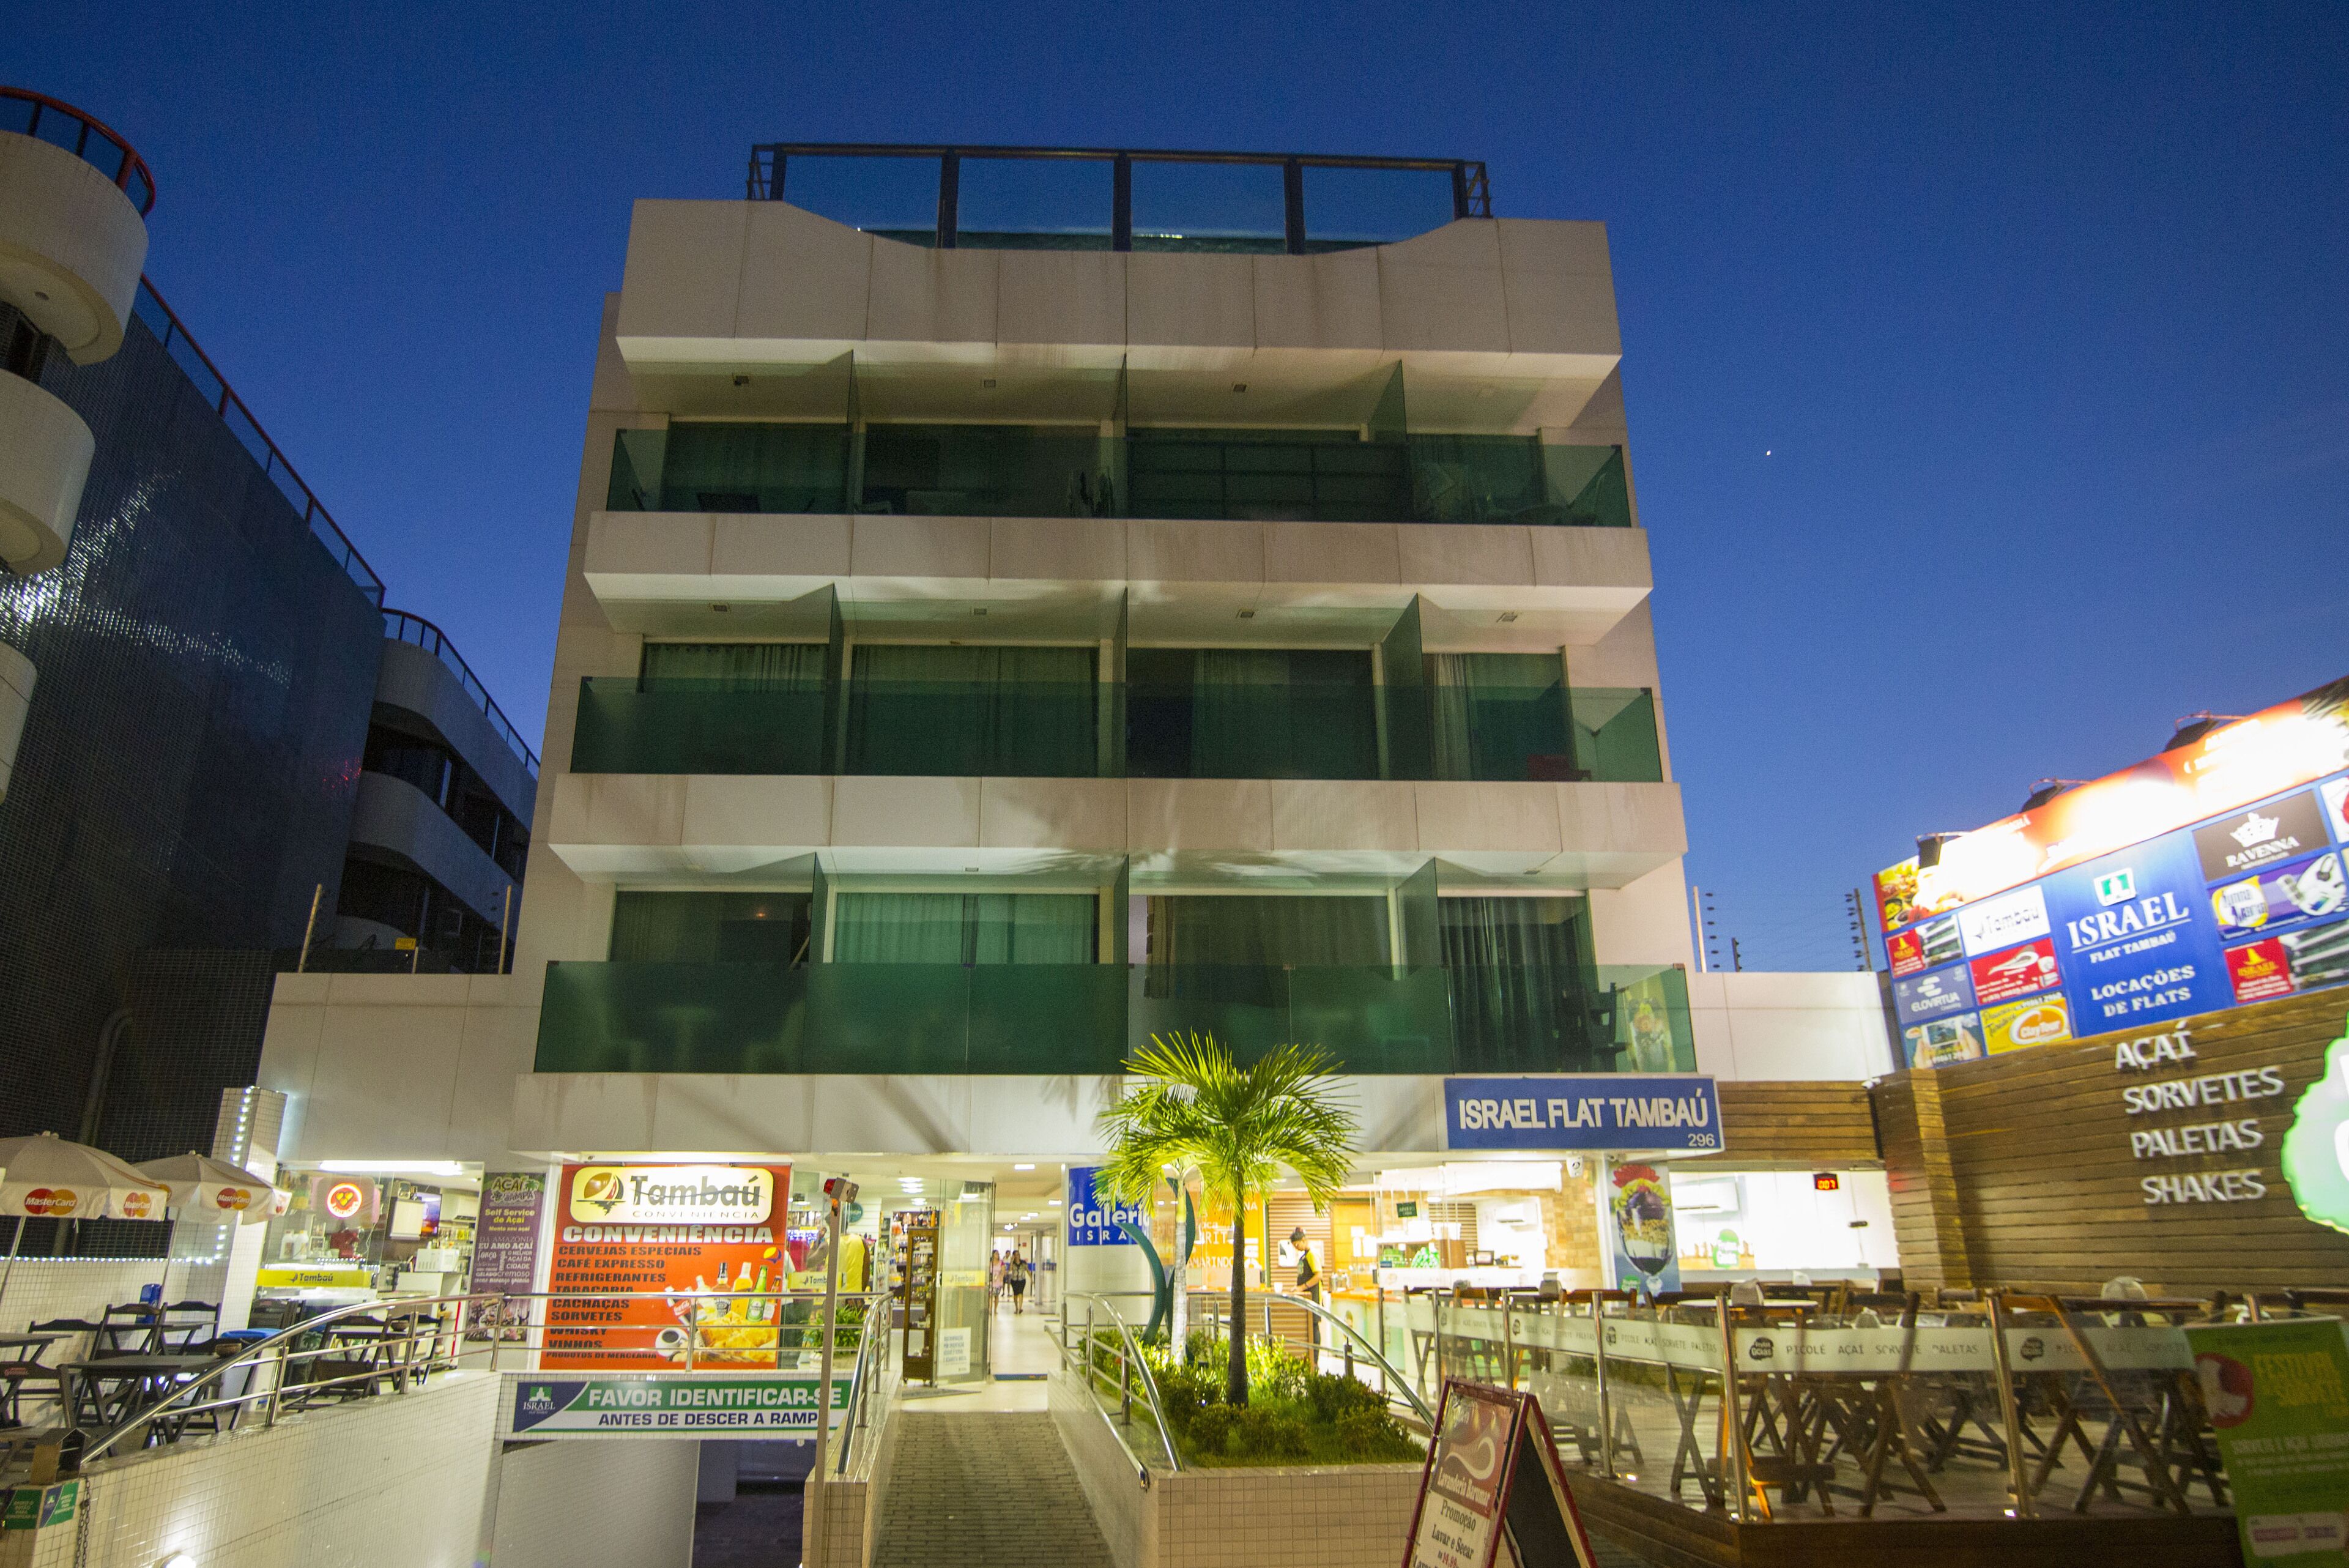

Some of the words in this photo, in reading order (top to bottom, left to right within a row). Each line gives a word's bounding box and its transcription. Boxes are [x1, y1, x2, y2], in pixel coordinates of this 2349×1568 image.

[2225, 836, 2300, 861] RAVENNA
[2066, 891, 2189, 948] ISRAEL
[2090, 946, 2121, 964] FLAT
[2091, 965, 2195, 1001] LOCAÇÕES
[2103, 1000, 2128, 1017] DE
[2131, 987, 2191, 1011] FLATS
[2115, 1020, 2197, 1070] AÇAÍ
[2122, 1065, 2285, 1114] SORVETES
[1460, 1099, 1546, 1129] ISRAEL
[1548, 1098, 1605, 1128] FLAT
[1609, 1088, 1709, 1128] TAMBAÚ
[1688, 1133, 1715, 1148] 296
[2130, 1118, 2263, 1158] PALETAS
[630, 1175, 761, 1206] Tambaú
[2140, 1169, 2267, 1204] SHAKES
[26, 1197, 76, 1206] MasterCard
[217, 1194, 251, 1203] MasterCard
[562, 1224, 774, 1244] CONVENIÊNCIA
[513, 1240, 533, 1251] AÇAÍ
[559, 1246, 627, 1255] CERVEJAS
[631, 1246, 702, 1255] ESPECIAIS
[557, 1257, 591, 1268] CAFÉ
[595, 1259, 665, 1268] EXPRESSO
[299, 1273, 333, 1282] Tambaú
[555, 1273, 666, 1282] REFRIGERANTES
[552, 1299, 629, 1310] CACHAÇAS
[551, 1311, 622, 1321] SORVETES
[548, 1340, 603, 1348] VINHOS
[588, 1389, 662, 1406] FAVOR
[599, 1414, 652, 1425] ANTES
[658, 1413, 678, 1425] DE
[685, 1413, 748, 1425] DESCER
[754, 1413, 765, 1424] A
[770, 1412, 818, 1424] RAMP
[1438, 1466, 1467, 1497] Lavanderia
[1441, 1499, 1476, 1533] Promoção
[1432, 1524, 1450, 1546] Lavar
[1450, 1538, 1455, 1549] e
[1455, 1536, 1474, 1559] Secar
